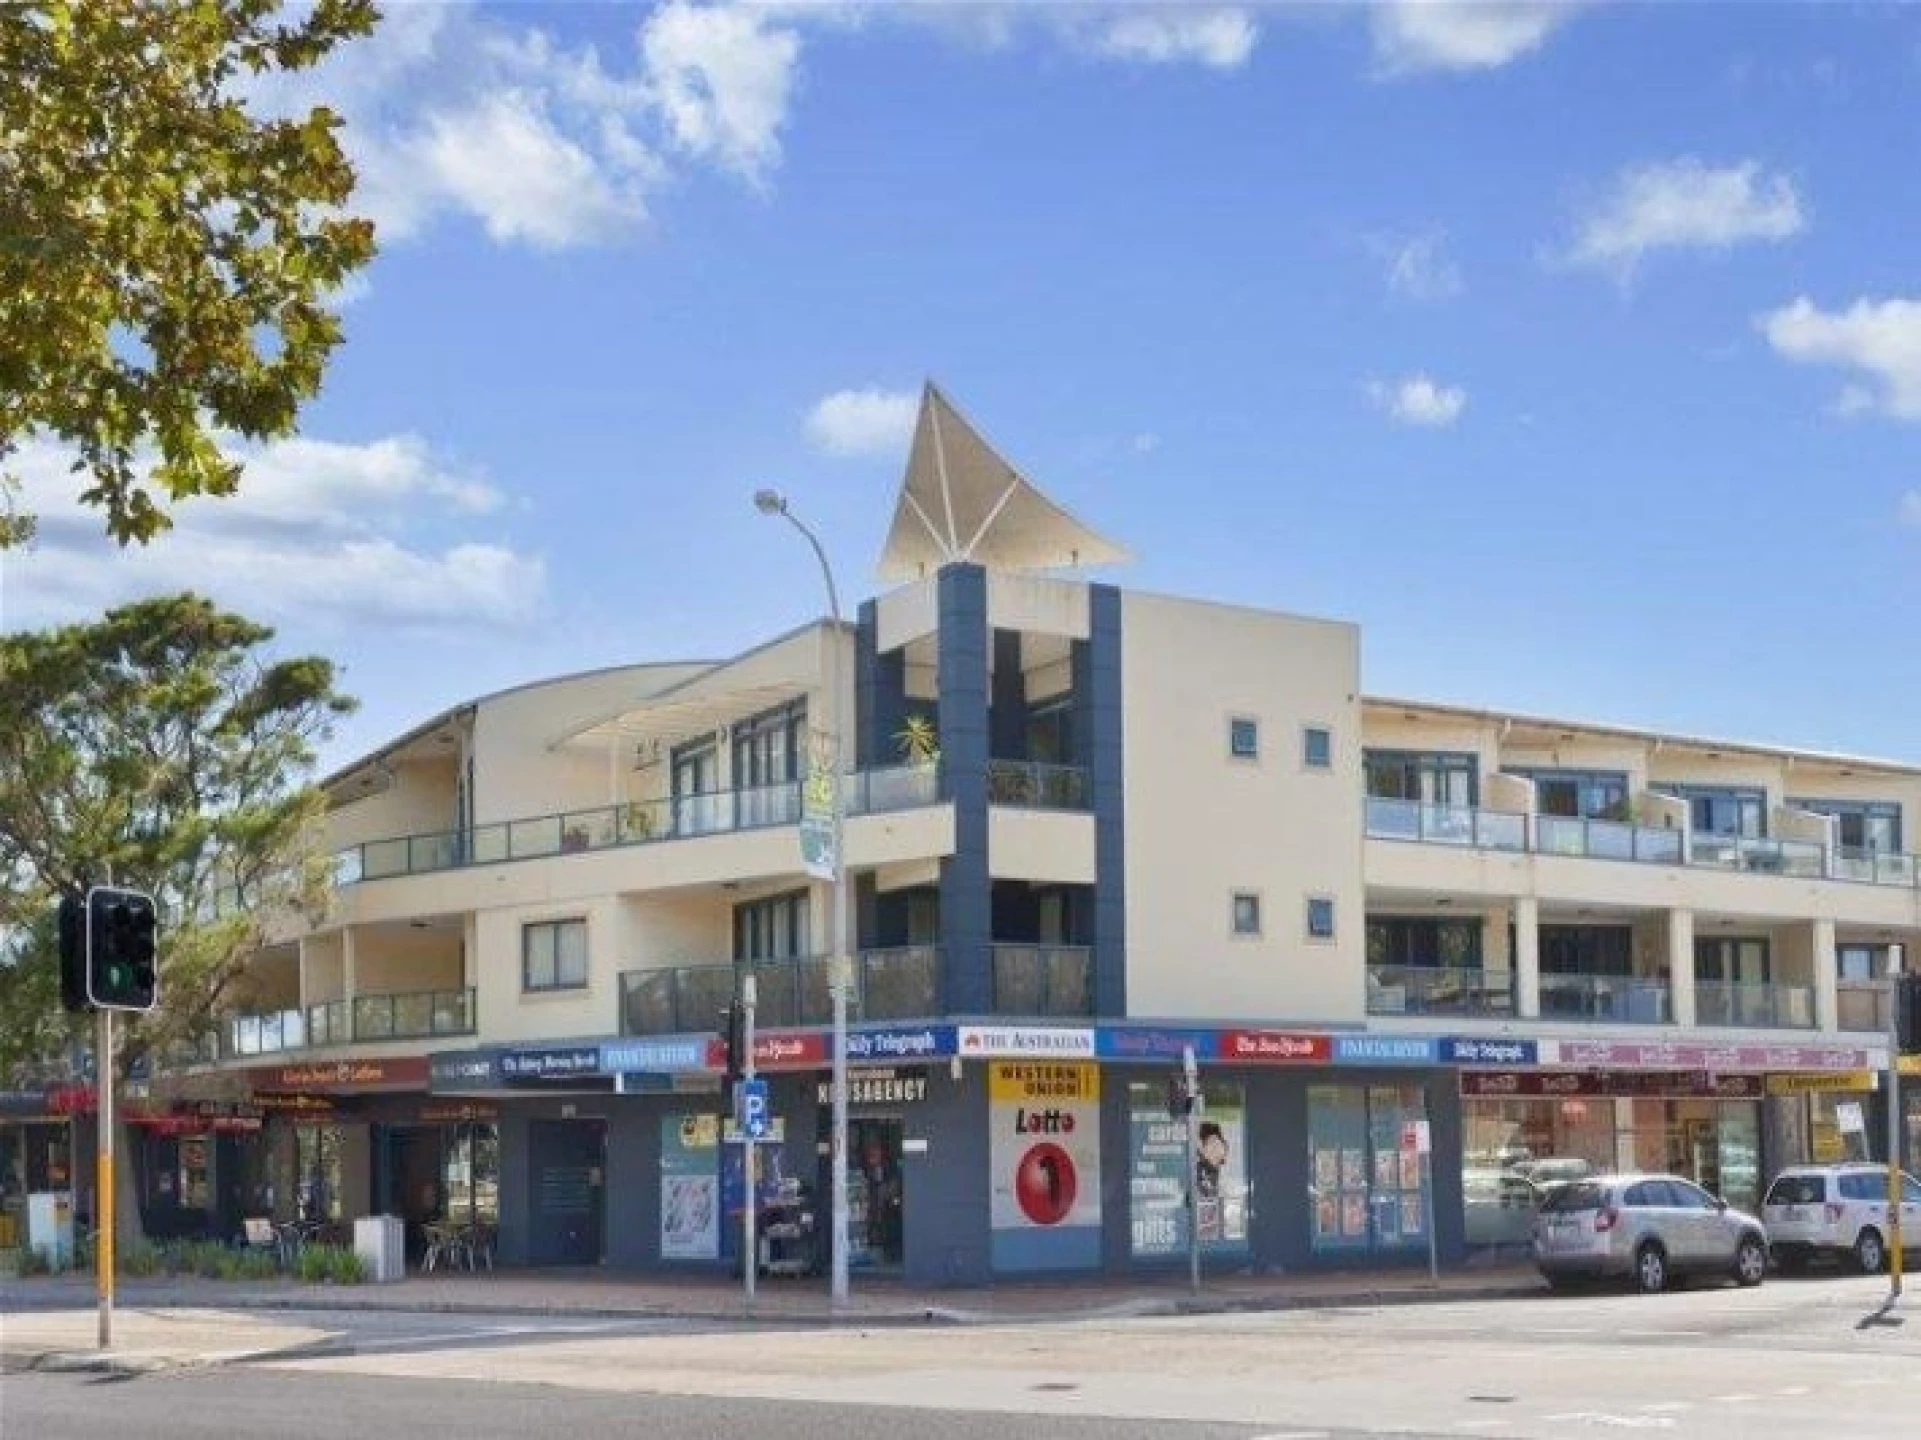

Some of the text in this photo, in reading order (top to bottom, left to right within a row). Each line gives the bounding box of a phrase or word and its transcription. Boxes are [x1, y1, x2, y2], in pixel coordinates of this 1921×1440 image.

[875, 1031, 935, 1054] Telegraph
[983, 1032, 1090, 1048] THE AUSTRALIAN
[1001, 1066, 1077, 1079] WESTERN
[818, 1077, 925, 1104] NSAGENCY
[1024, 1081, 1077, 1097] UNION
[746, 1096, 763, 1125] P
[1016, 1108, 1076, 1134] Lotto
